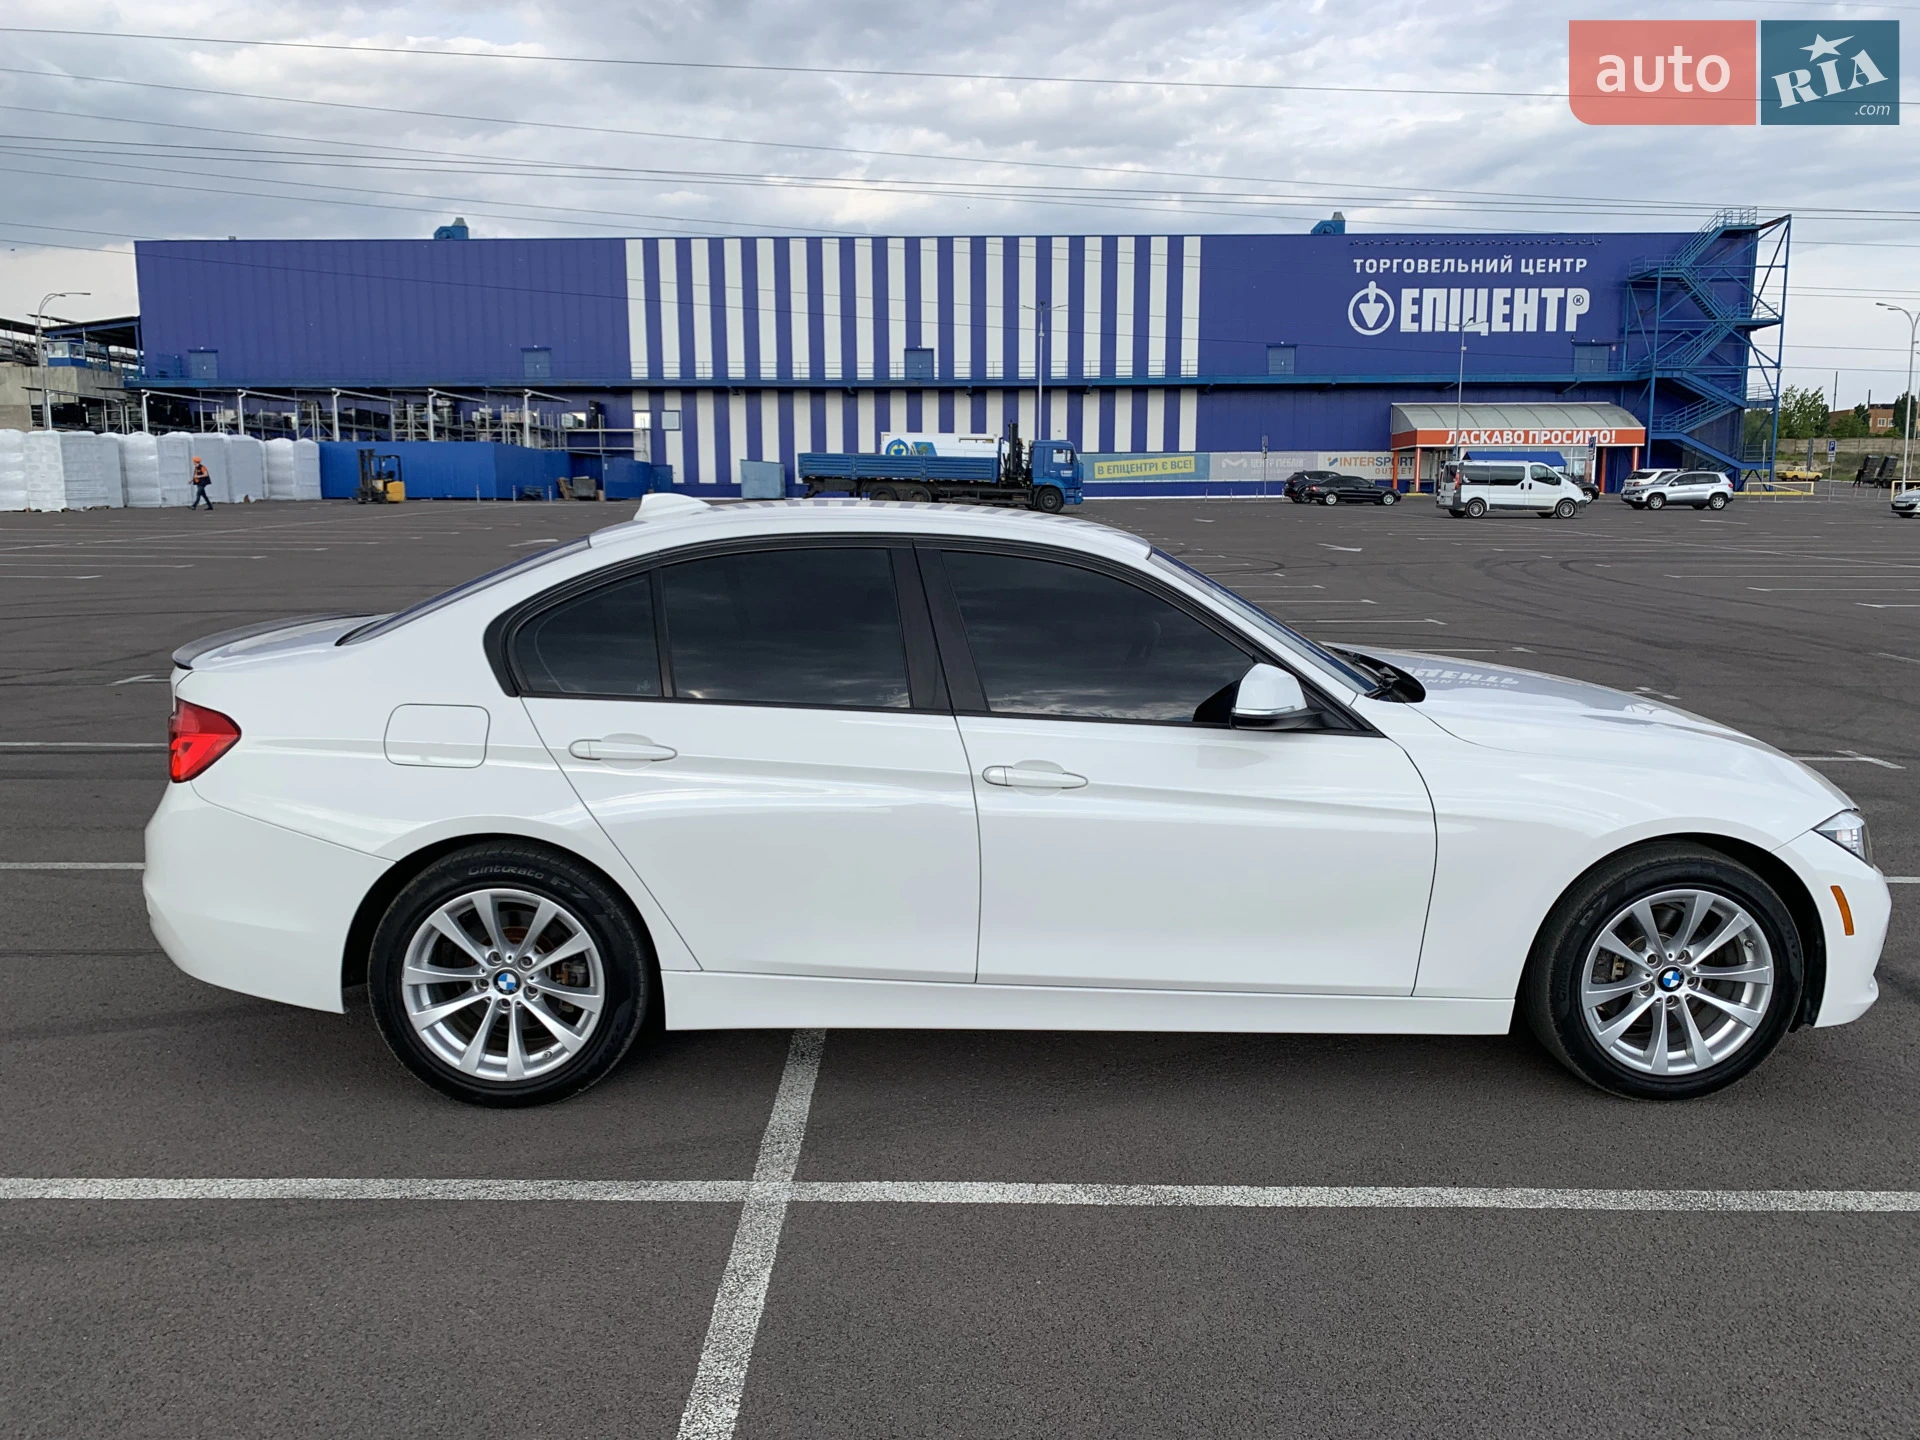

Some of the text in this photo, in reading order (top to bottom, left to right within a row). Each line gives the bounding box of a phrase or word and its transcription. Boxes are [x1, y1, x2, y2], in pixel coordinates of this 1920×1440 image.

[1353, 255, 1588, 275] ТОРГОВЕЛЬНИЙ ЦЕНТР
[1400, 288, 1590, 336] ЕПІЦЕНТР
[1446, 429, 1616, 445] ЛАСКАВО ПРОСИМО!
[1097, 459, 1192, 475] В ЕПІЦЕНТРІ Є ВСЕ!
[1375, 467, 1413, 475] OUTET
